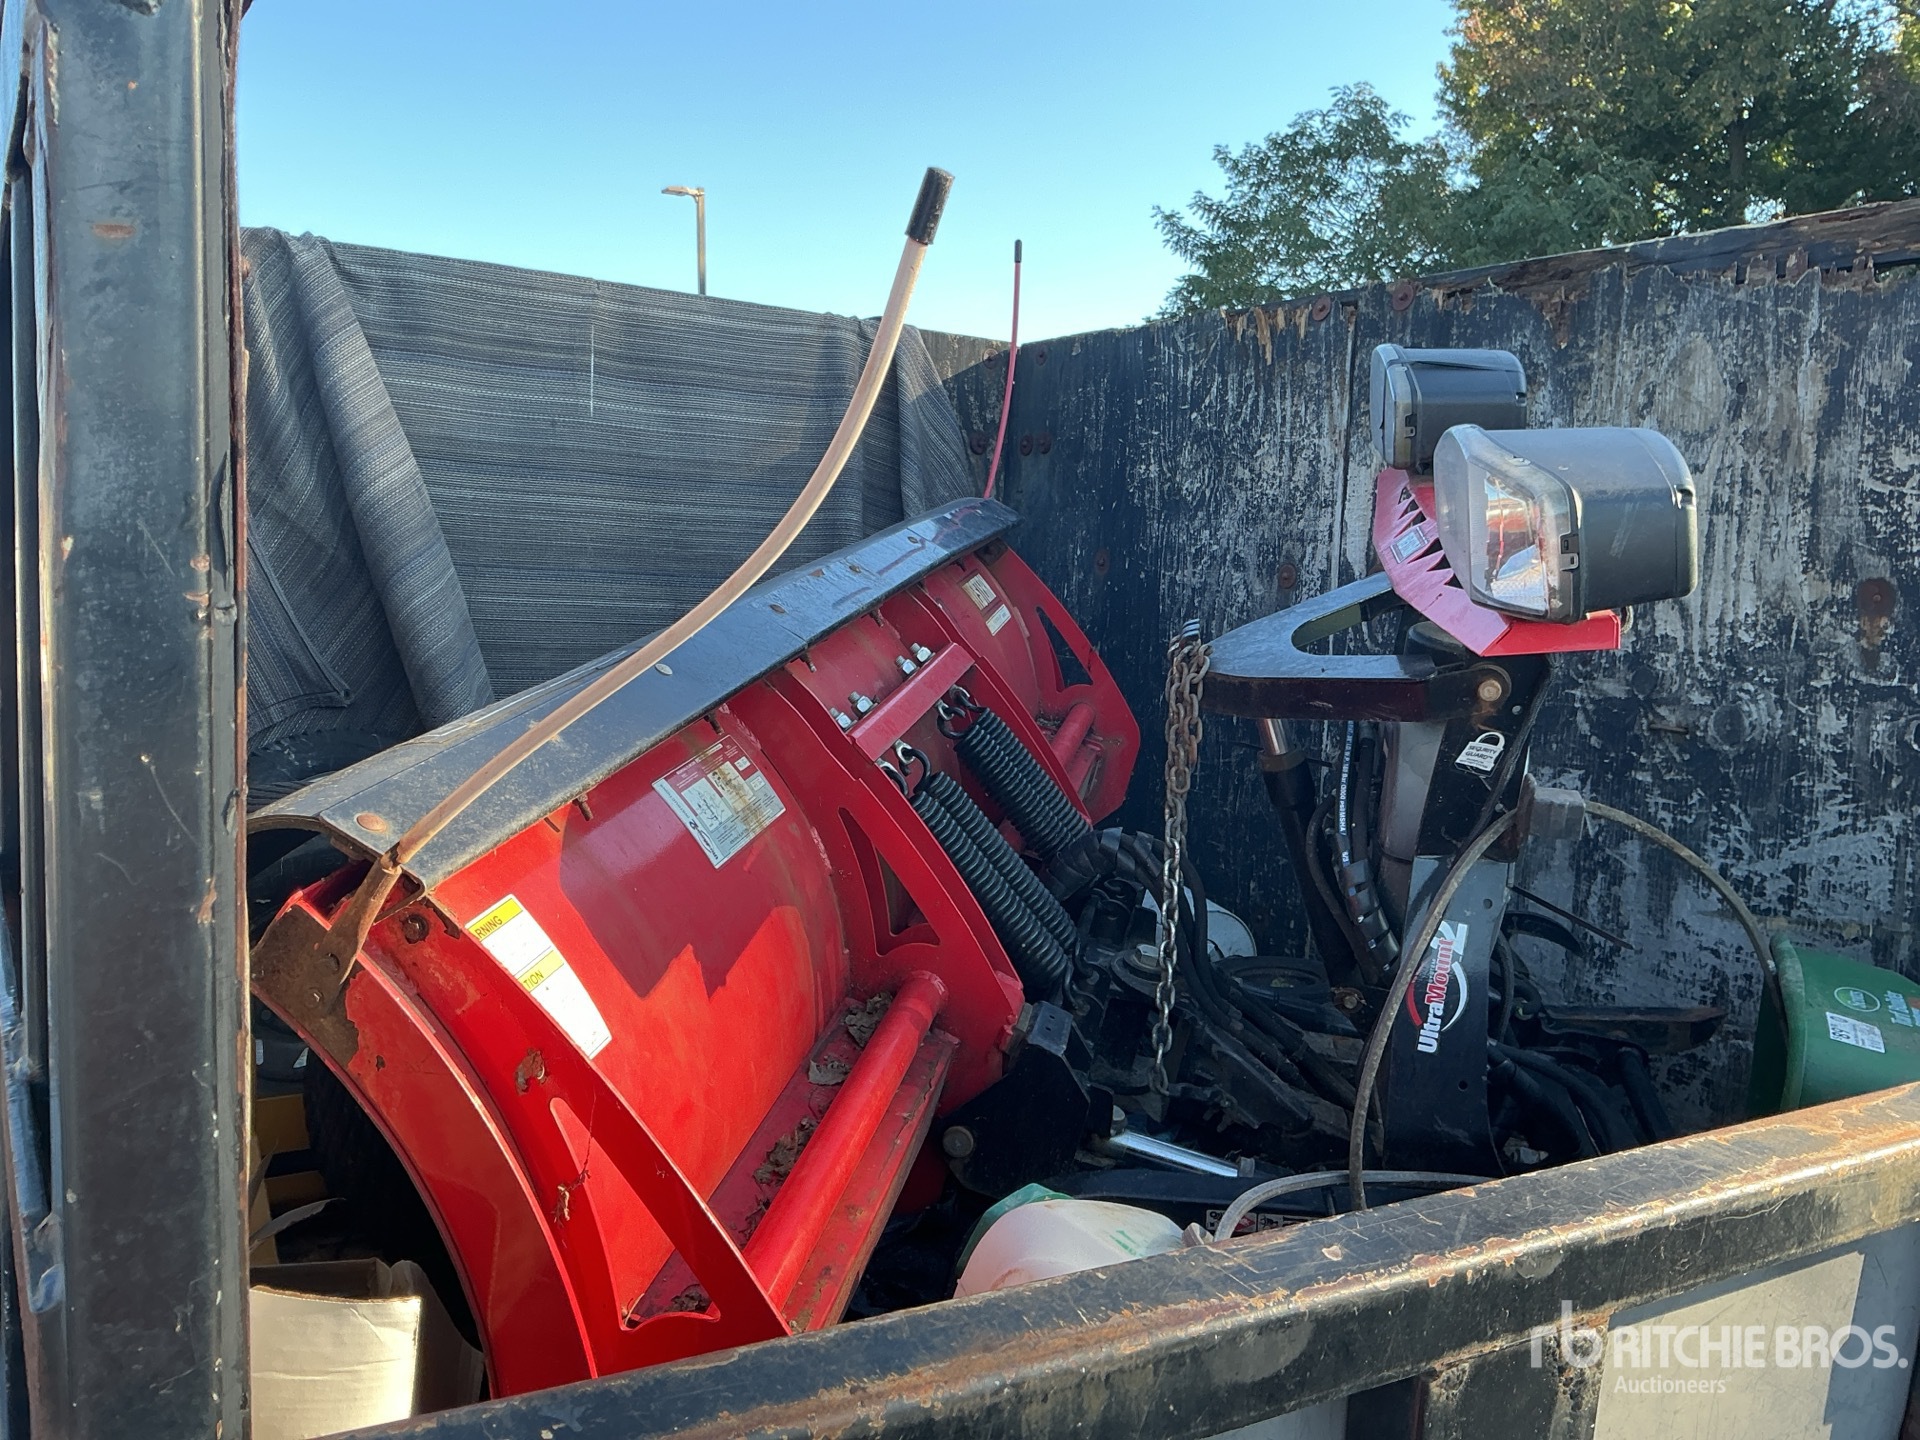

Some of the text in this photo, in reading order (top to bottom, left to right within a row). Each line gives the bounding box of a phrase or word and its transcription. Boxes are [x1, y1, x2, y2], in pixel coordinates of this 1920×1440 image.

[1469, 745, 1497, 755] SECURITY
[474, 915, 503, 939] RNING
[1417, 920, 1468, 1054] UltraMount 2
